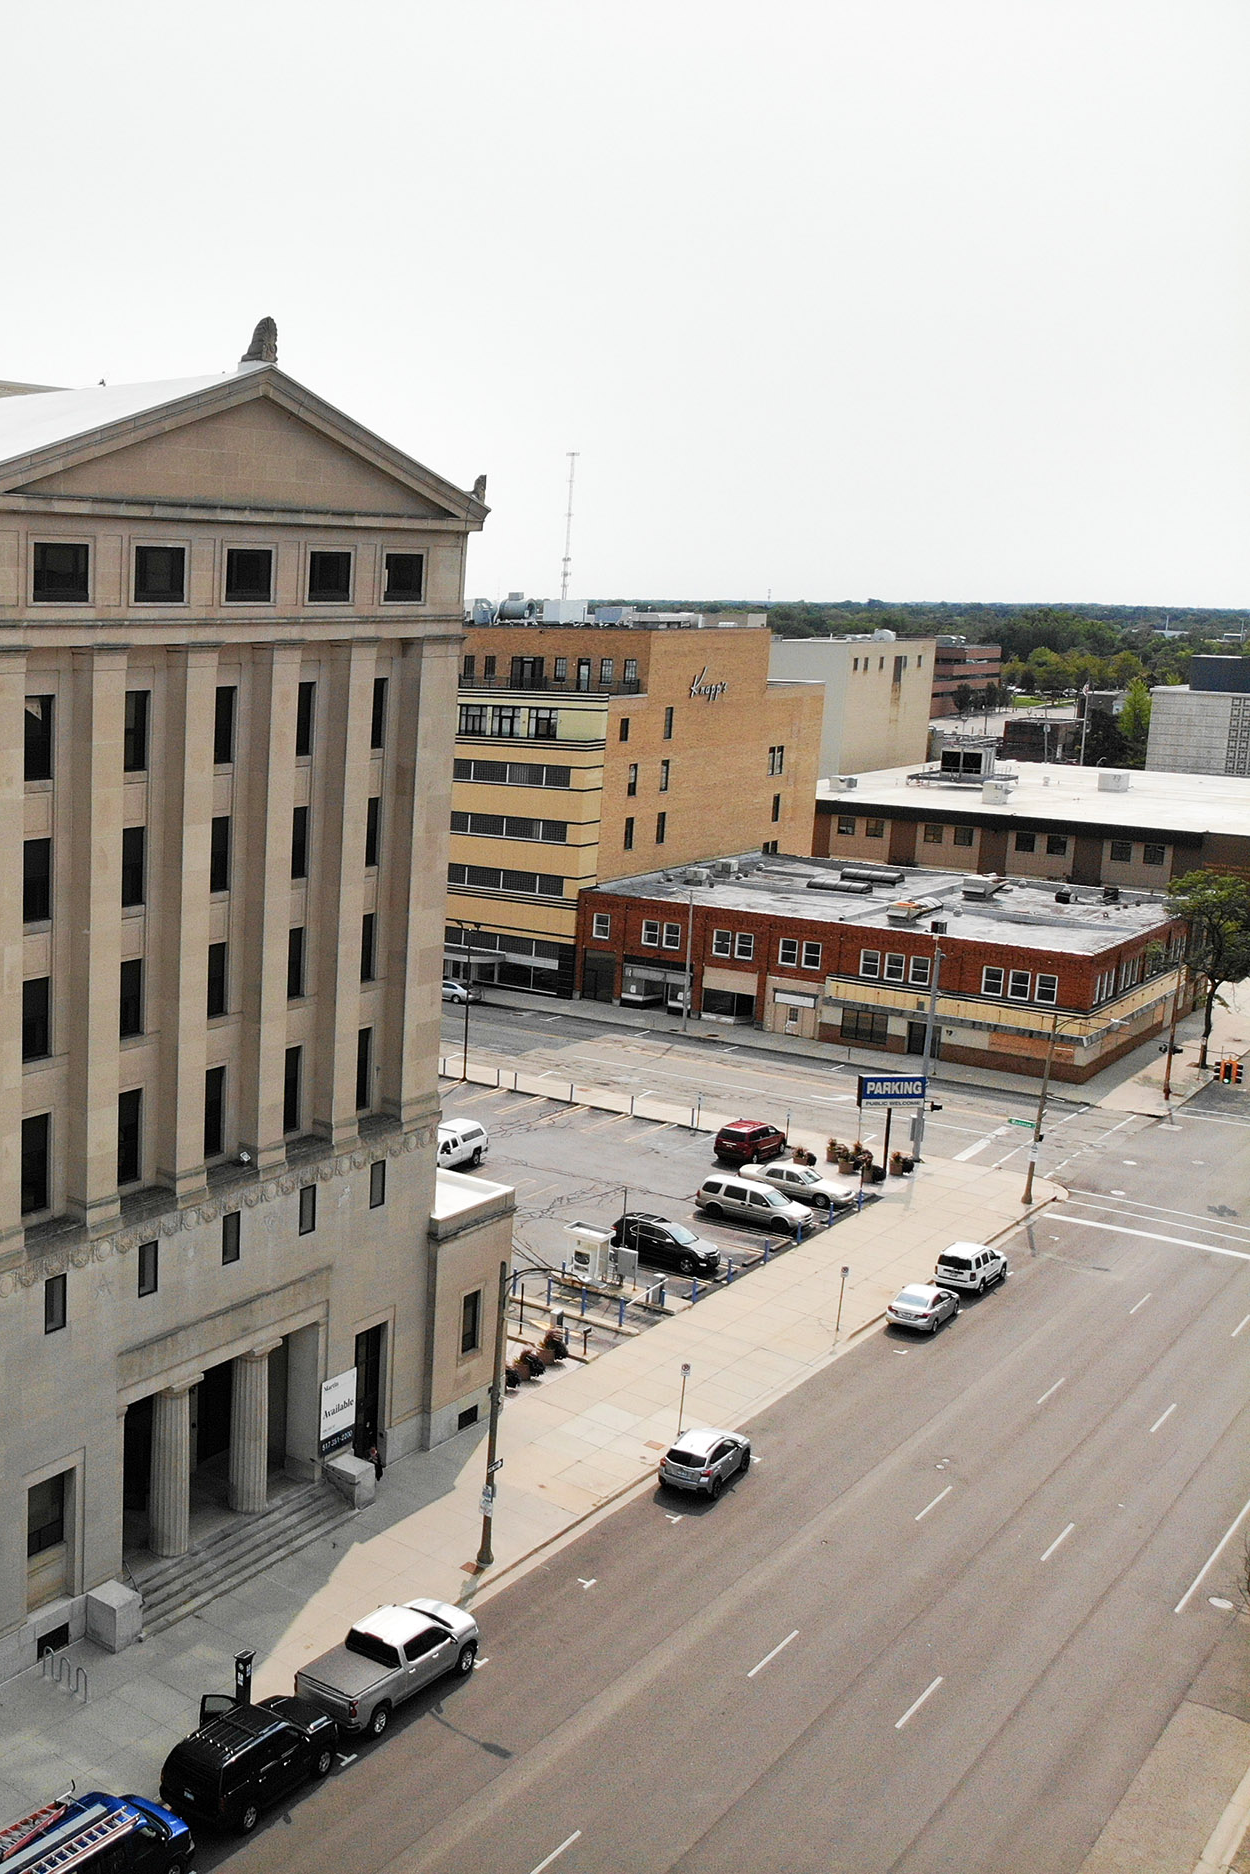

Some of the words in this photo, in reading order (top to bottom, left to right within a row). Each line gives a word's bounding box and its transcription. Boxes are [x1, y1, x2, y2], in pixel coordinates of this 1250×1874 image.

[689, 666, 728, 702] Knapp's
[866, 1081, 922, 1095] PARKING
[324, 1382, 339, 1392] Martin
[322, 1398, 354, 1419] Available
